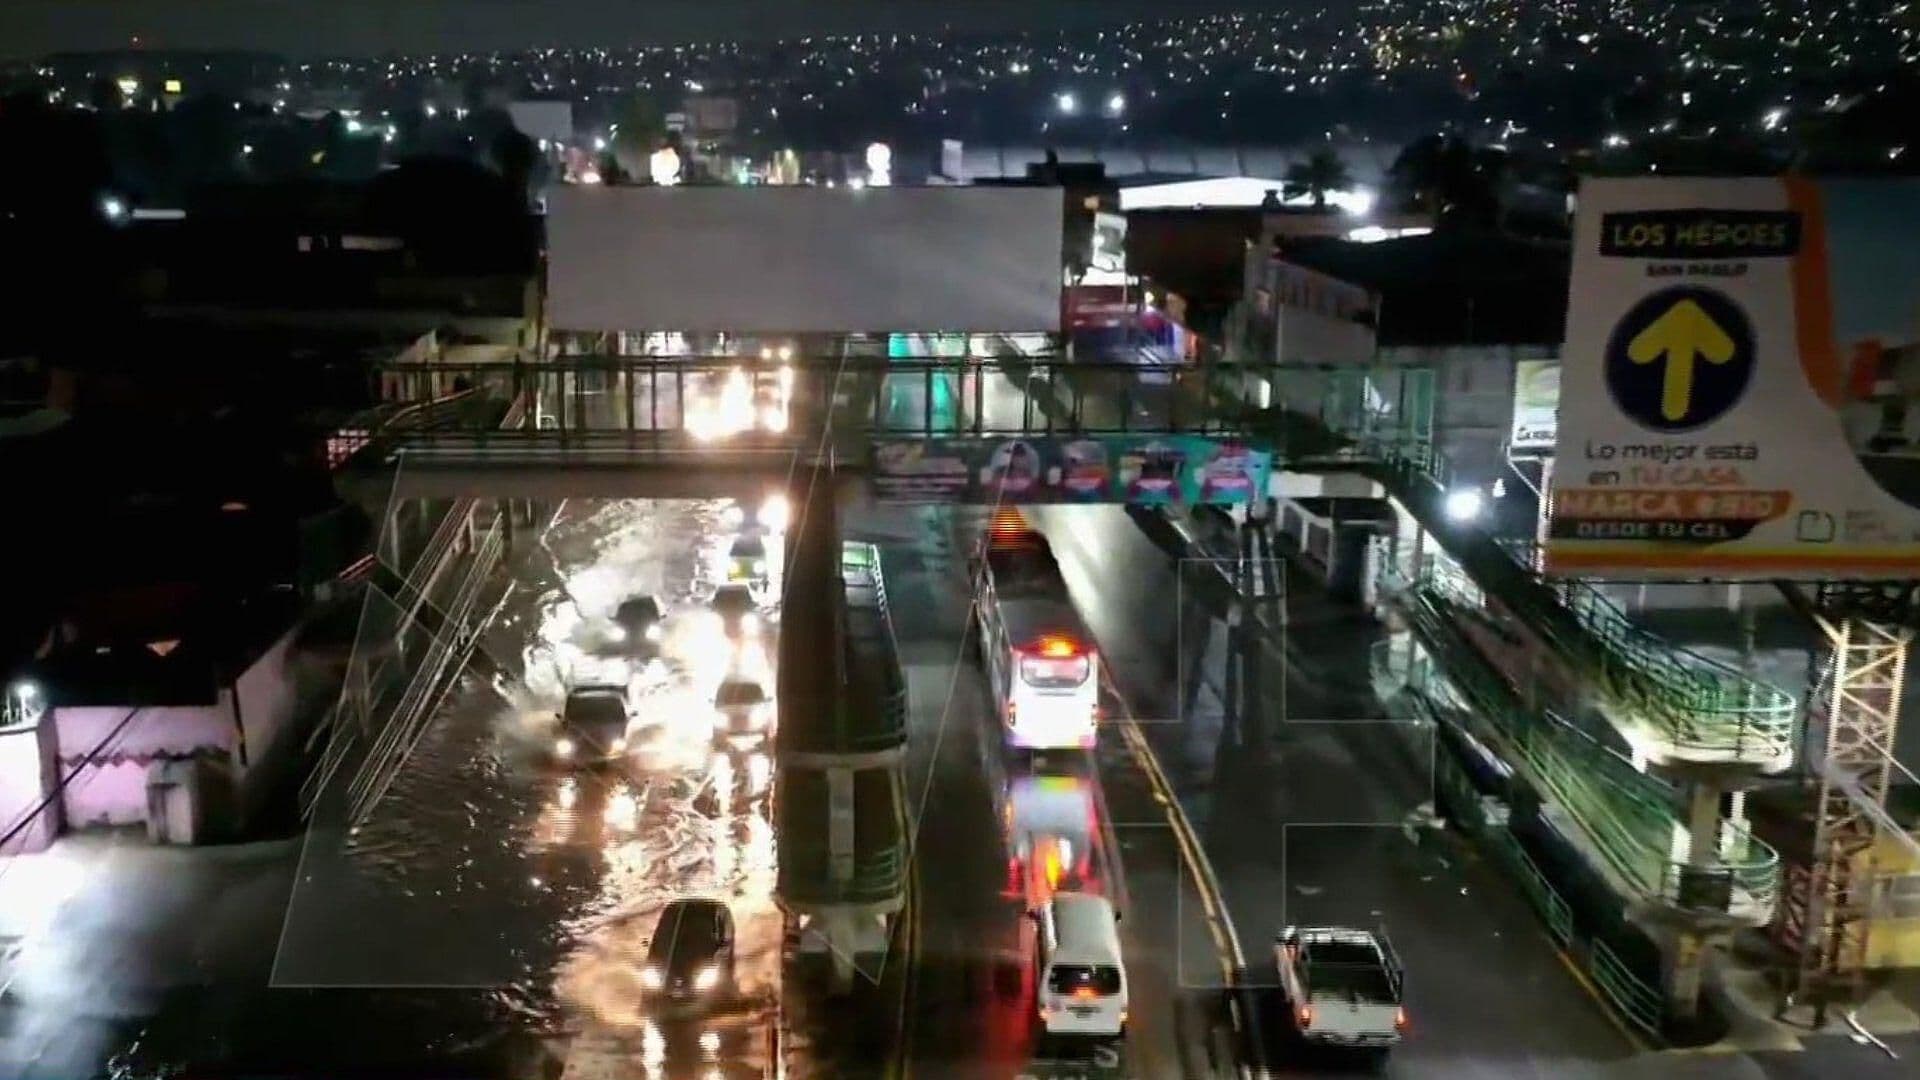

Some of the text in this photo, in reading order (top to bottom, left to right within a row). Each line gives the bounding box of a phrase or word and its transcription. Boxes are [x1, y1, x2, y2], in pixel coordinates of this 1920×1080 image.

[1614, 223, 1667, 247] LOS
[1583, 438, 1617, 460] Lo
[1622, 442, 1697, 465] mejor
[1587, 465, 1745, 486] en TU CASA
[1559, 491, 1681, 517] MARCA
[1577, 521, 1727, 539] DESDE TU CEL
